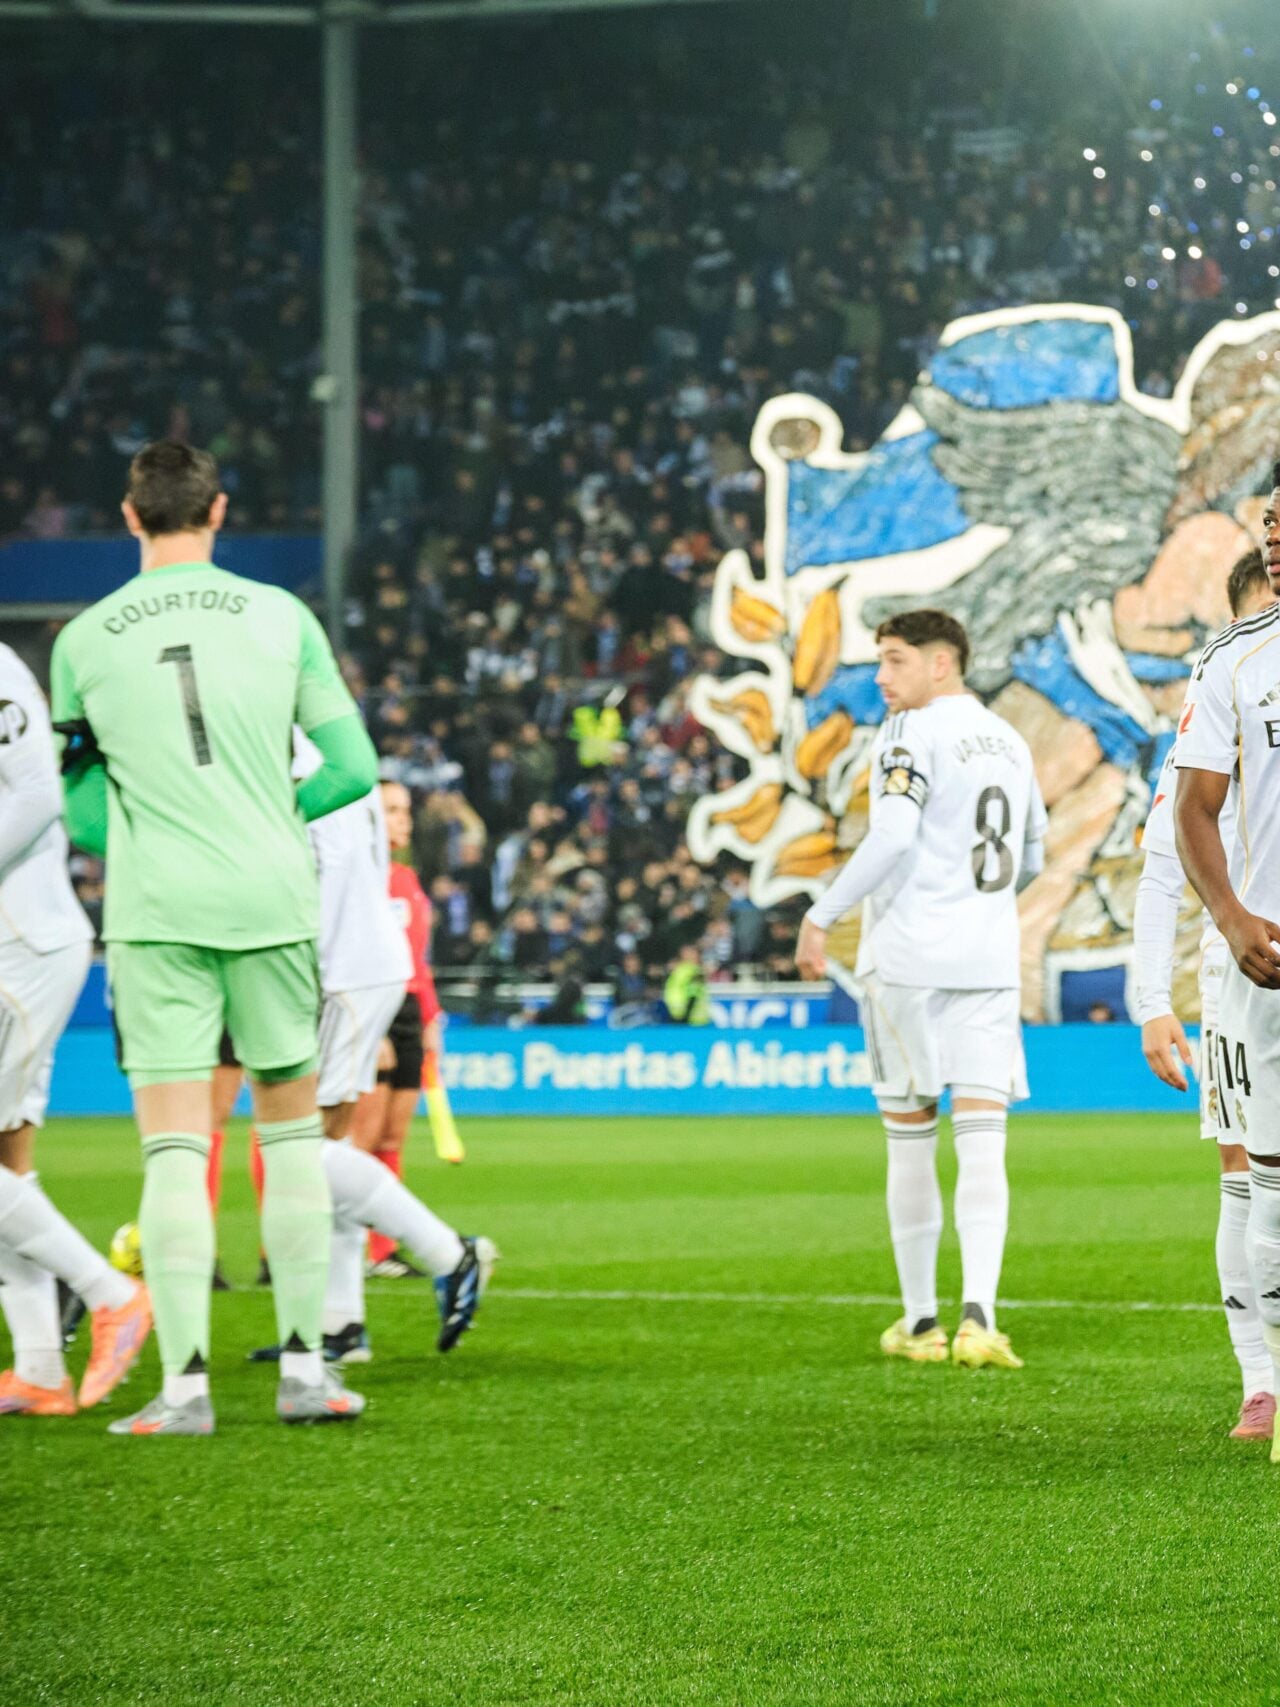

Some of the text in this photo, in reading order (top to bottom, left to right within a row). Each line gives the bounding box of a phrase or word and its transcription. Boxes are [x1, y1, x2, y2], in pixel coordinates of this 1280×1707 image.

[103, 589, 248, 635] COURTOIS
[156, 643, 213, 767] 1
[972, 785, 1013, 893] 8
[523, 1042, 697, 1090] Puertas
[703, 1040, 873, 1088] Abierta
